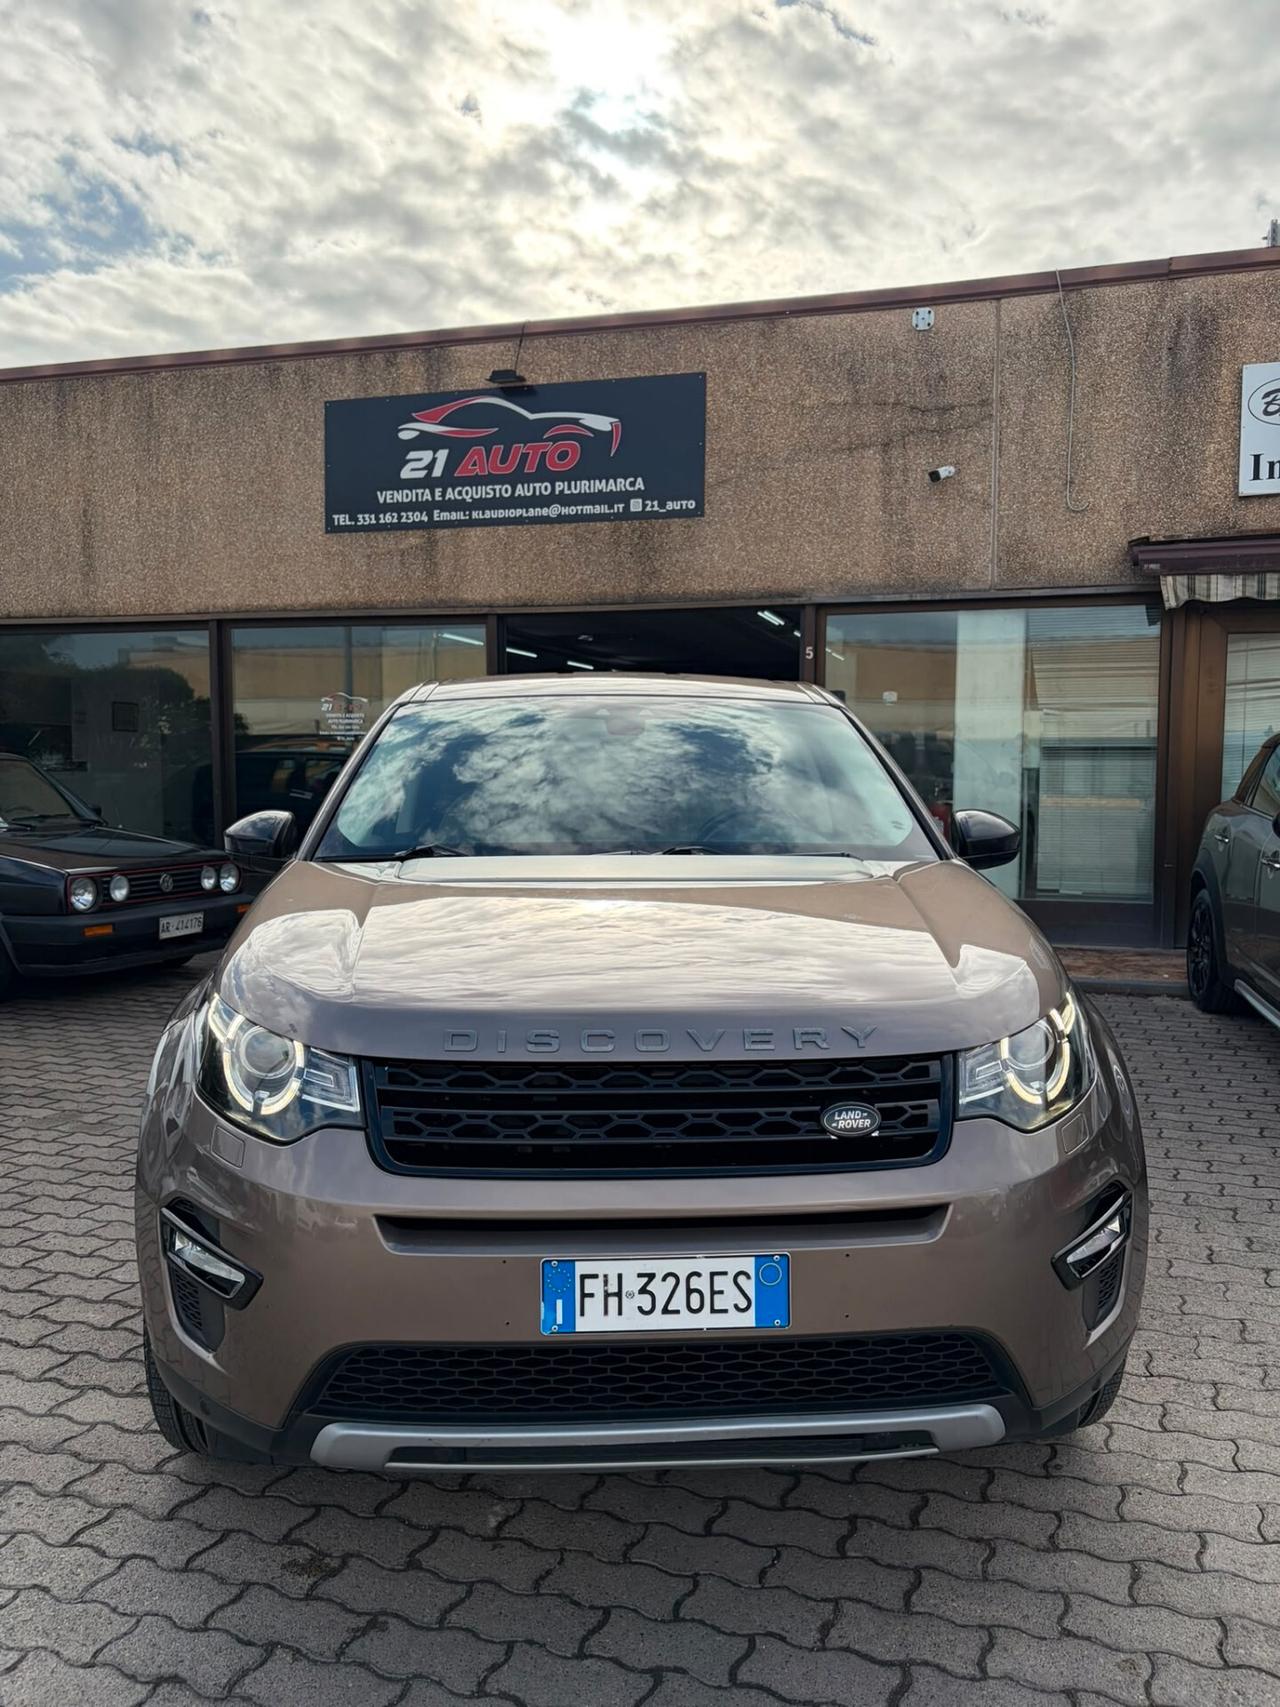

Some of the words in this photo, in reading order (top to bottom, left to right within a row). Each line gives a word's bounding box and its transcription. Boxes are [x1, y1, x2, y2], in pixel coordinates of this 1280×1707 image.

[400, 449, 449, 479] 21
[454, 440, 582, 477] AUTO
[377, 488, 432, 504] VENDITA
[434, 487, 443, 501] E
[445, 484, 512, 502] ACQUISTO
[515, 482, 551, 497] AUTO
[555, 477, 645, 495] PLURIMARCA
[332, 514, 355, 526] TEL.
[357, 514, 376, 525] 331
[379, 512, 398, 524] 162
[400, 511, 428, 522] 2304
[805, 646, 814, 659] 5
[443, 1025, 878, 1054] DISCOVERY
[834, 1110, 862, 1120] LAND
[838, 1119, 871, 1129] ROVER
[579, 1270, 752, 1317] FH326ES
